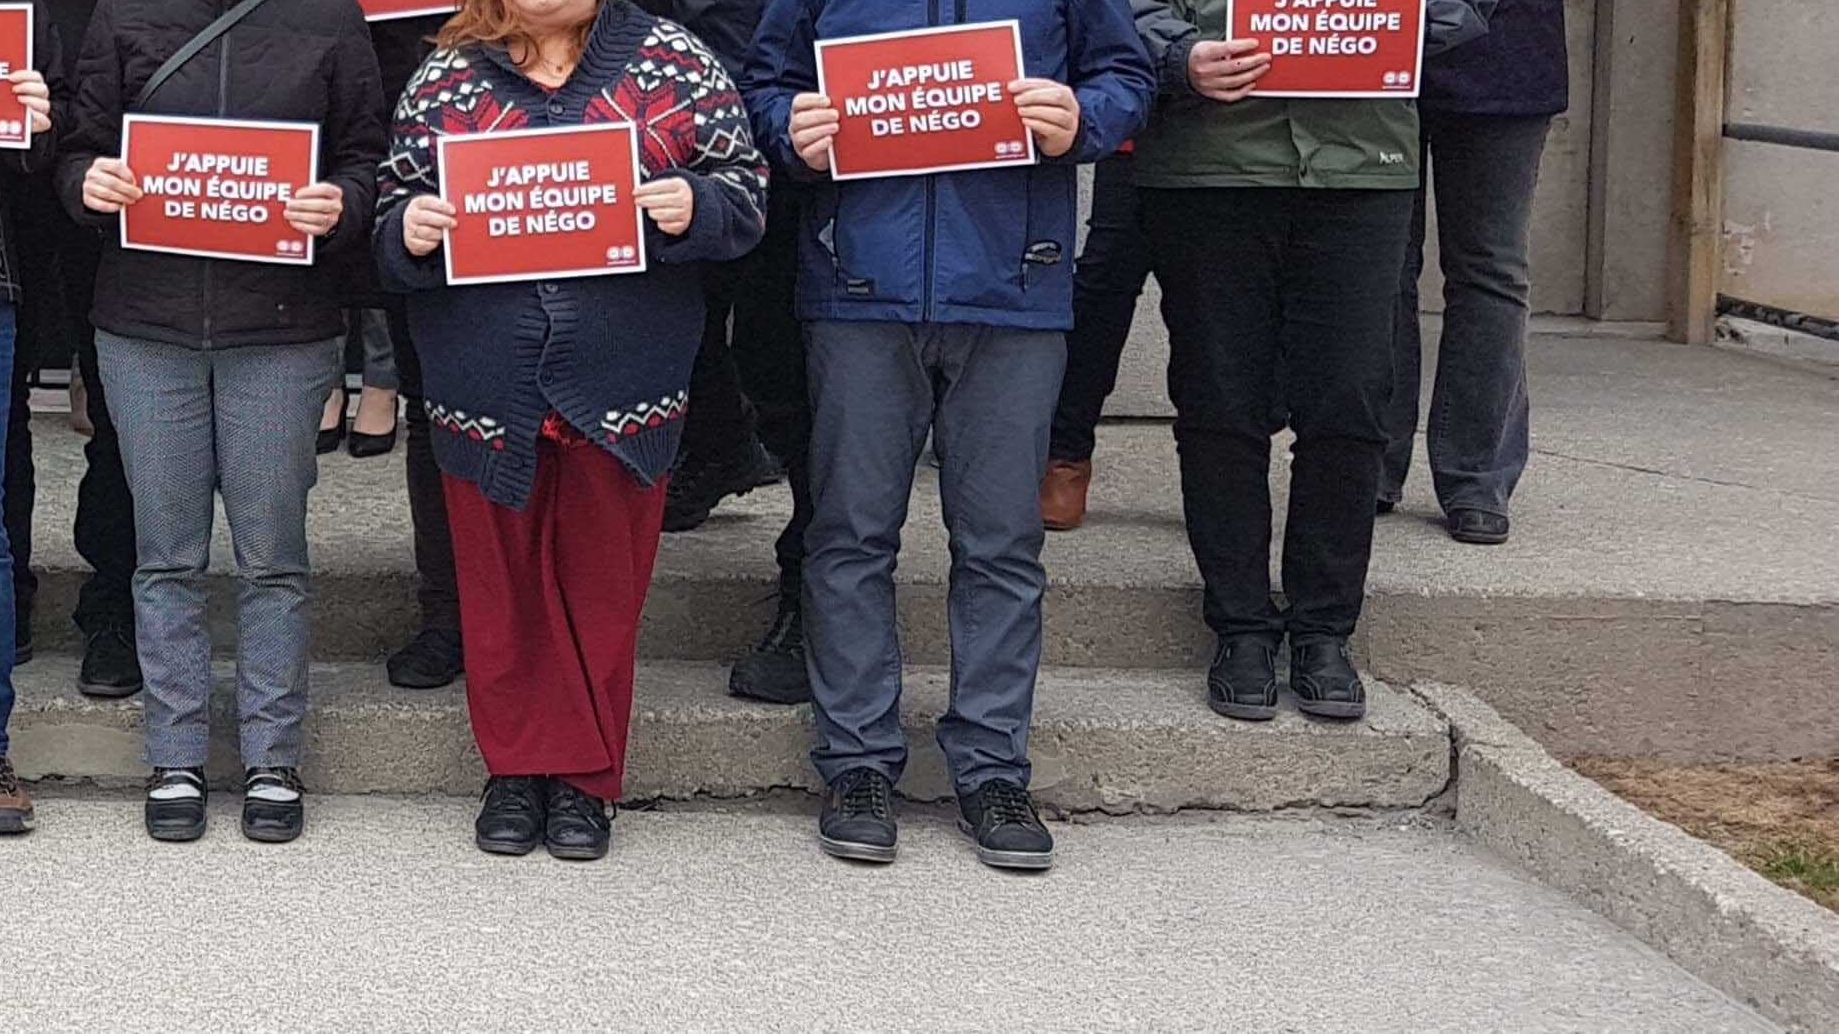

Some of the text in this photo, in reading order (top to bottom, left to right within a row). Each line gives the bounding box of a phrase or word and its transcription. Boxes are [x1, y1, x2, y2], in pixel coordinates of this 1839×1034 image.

[1250, 10, 1401, 31] MON ÉQUIPE
[1272, 33, 1377, 55] DE NÉGO
[867, 60, 974, 90] J'APPUIE
[845, 82, 1002, 116] MON ÉQUIPE
[871, 110, 981, 137] DE NÉGO
[167, 152, 269, 176] J'APPUIE
[487, 160, 590, 188] J'APPUIE
[142, 176, 291, 202] MON ÉQUIPE
[465, 184, 617, 214] MON ÉQUIPE
[165, 200, 269, 223] DE NÉGO
[489, 209, 595, 236] DE NÉGO
